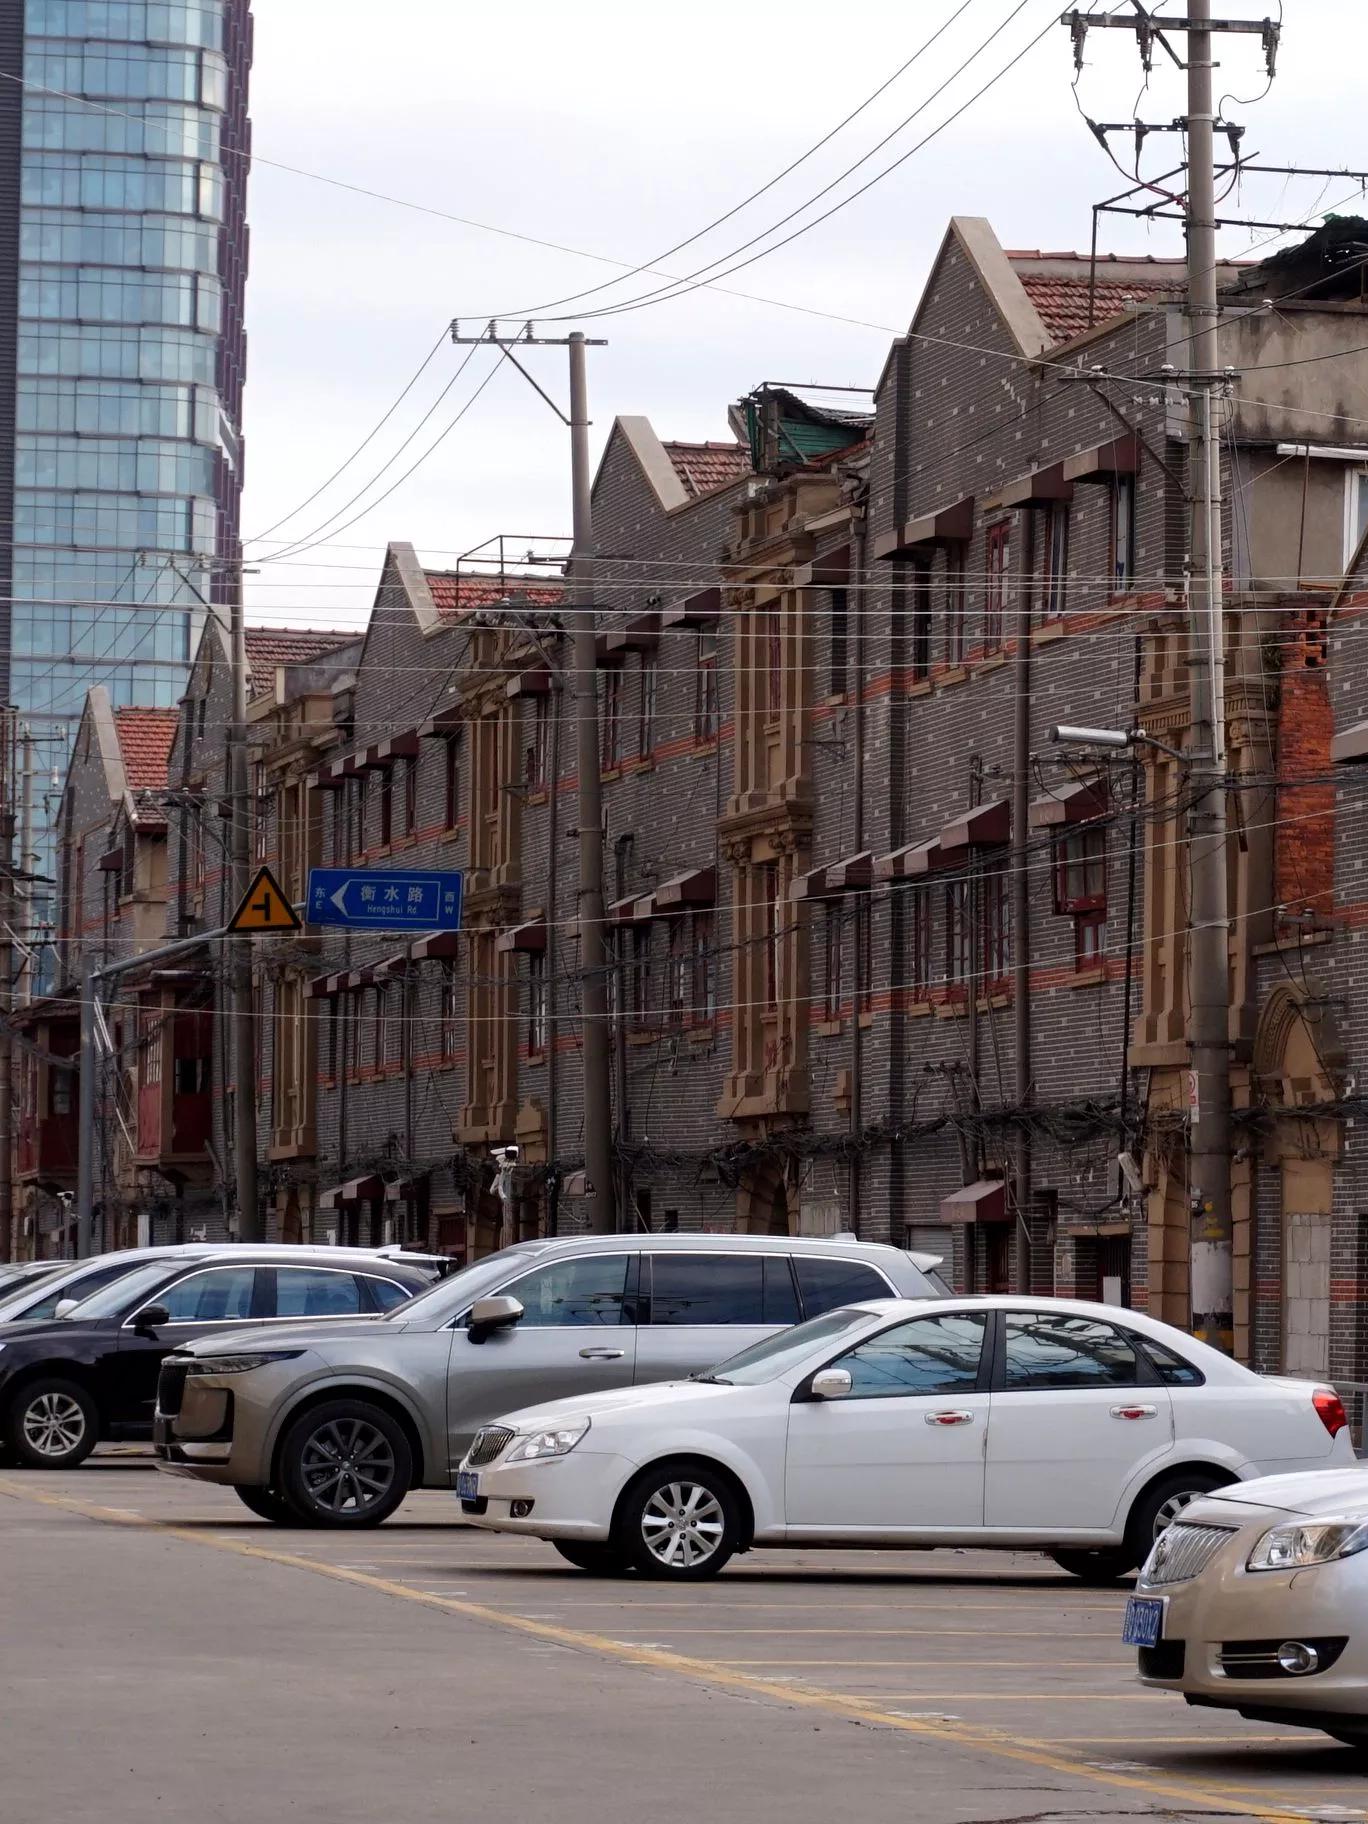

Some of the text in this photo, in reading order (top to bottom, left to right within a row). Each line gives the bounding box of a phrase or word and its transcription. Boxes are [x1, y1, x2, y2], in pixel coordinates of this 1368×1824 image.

[314, 887, 326, 898] 东
[360, 885, 424, 903] 衡水路
[444, 891, 455, 902] 西
[315, 901, 323, 910] E
[367, 904, 417, 915] Hengshui Rd
[445, 905, 454, 915] W
